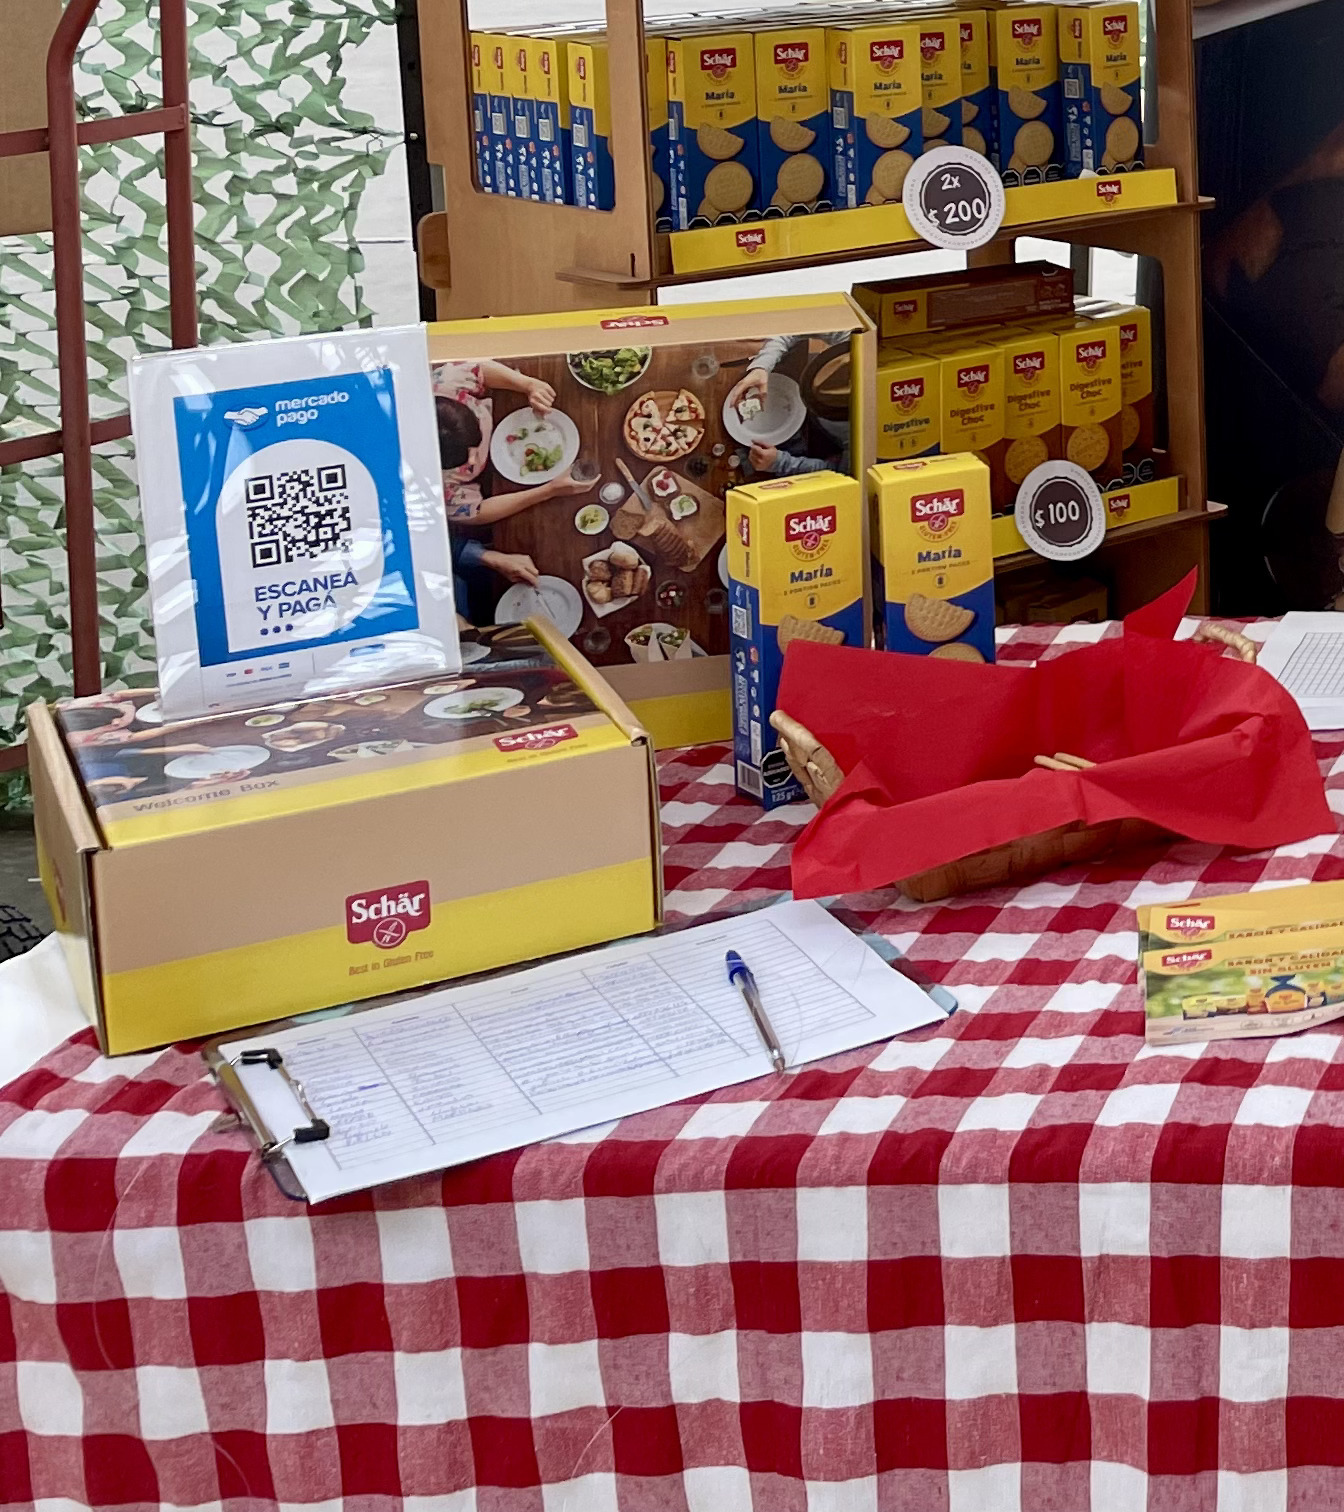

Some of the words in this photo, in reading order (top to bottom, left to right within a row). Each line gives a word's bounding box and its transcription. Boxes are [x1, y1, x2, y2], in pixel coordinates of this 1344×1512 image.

[1014, 22, 1040, 36] Schär
[776, 46, 806, 61] Schär
[872, 44, 901, 57] Schär
[703, 53, 734, 67] Schär
[941, 173, 961, 190] 2x
[944, 197, 986, 225] 200
[960, 370, 987, 384] Schär
[1069, 376, 1112, 392] Digestive
[893, 383, 921, 397] Schär
[1007, 388, 1051, 404] Digestive
[1080, 388, 1103, 400] Choc
[275, 390, 350, 411] mercado
[1018, 400, 1041, 412] Choc
[276, 408, 319, 427] pago
[950, 402, 995, 419] Digestive
[883, 415, 931, 433] Digestive
[961, 414, 985, 426] Choc
[914, 493, 960, 516] Schär
[1034, 510, 1045, 529] $
[1048, 500, 1080, 525] 100
[789, 514, 833, 535] Schär
[917, 544, 963, 564] Maria
[789, 563, 833, 584] Maria
[254, 570, 359, 603] ESCANEÁ
[257, 605, 272, 621] Y
[278, 593, 339, 619] PAGÁ
[132, 788, 232, 812] Welcome
[240, 777, 280, 792] Box
[351, 892, 426, 924] Schär
[348, 963, 369, 976] Best
[415, 950, 434, 961] Free
